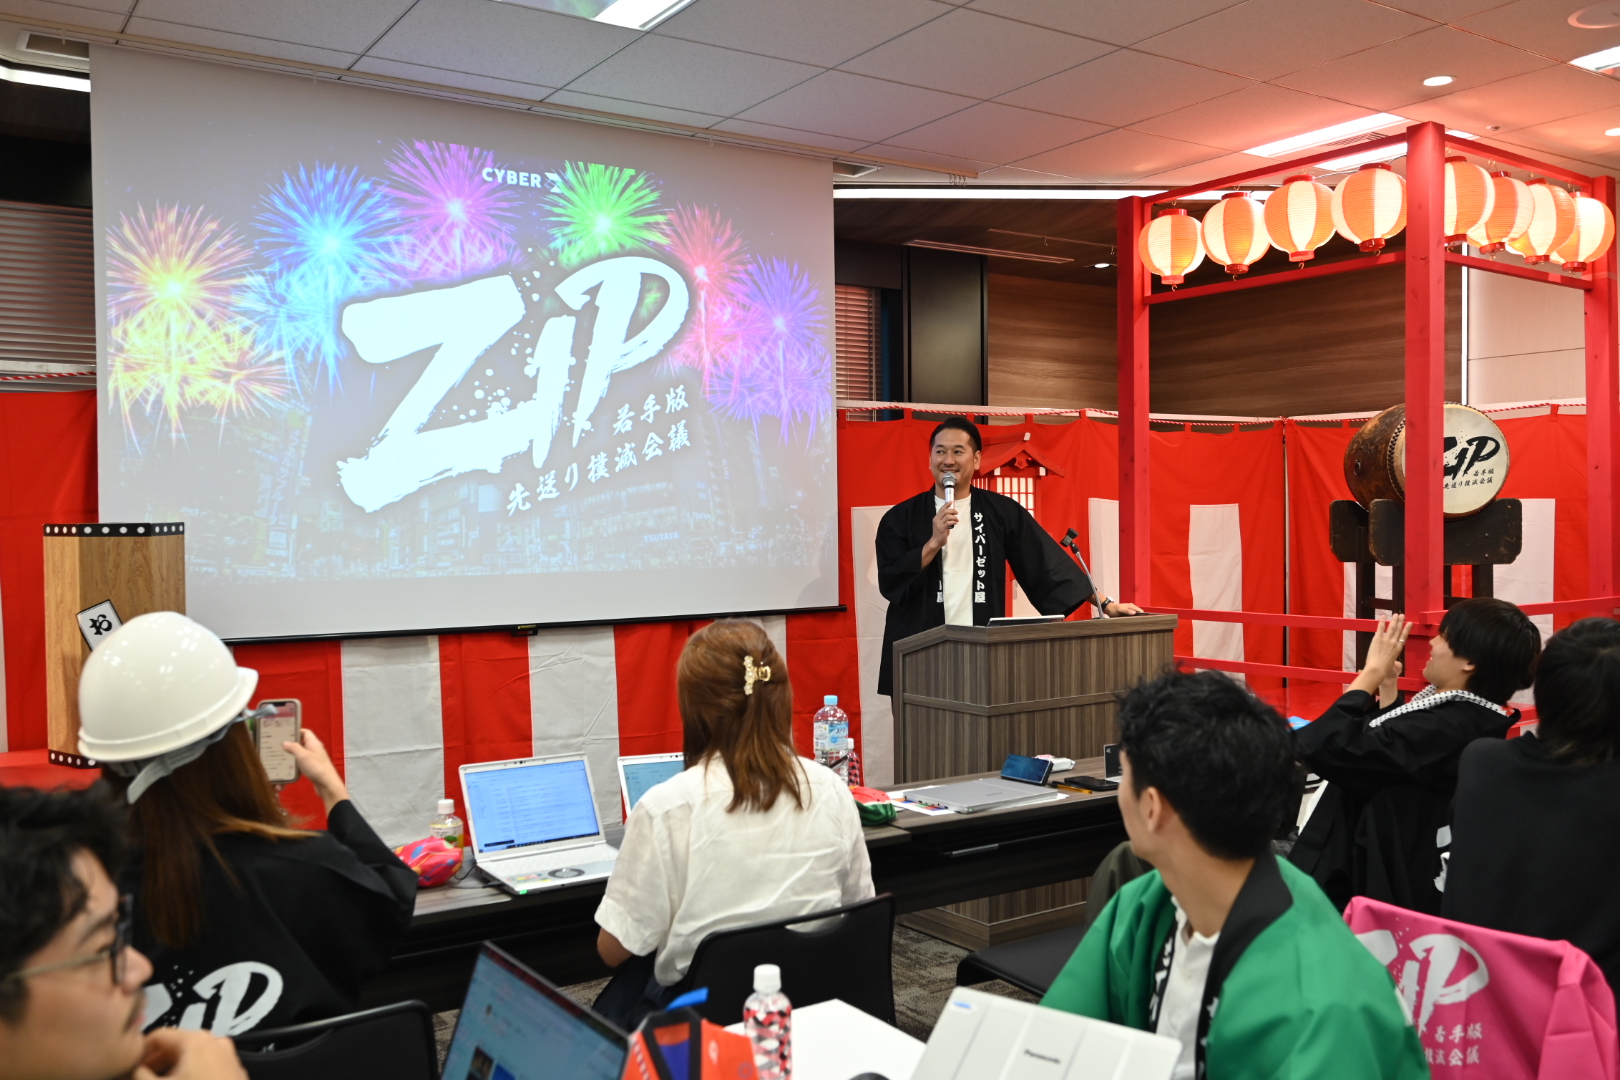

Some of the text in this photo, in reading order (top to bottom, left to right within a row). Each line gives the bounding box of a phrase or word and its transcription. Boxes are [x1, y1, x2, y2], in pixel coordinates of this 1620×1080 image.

[613, 385, 689, 435] 若手版
[506, 419, 691, 517] 先送り撲滅会議
[973, 512, 987, 603] サイバーゼット屋
